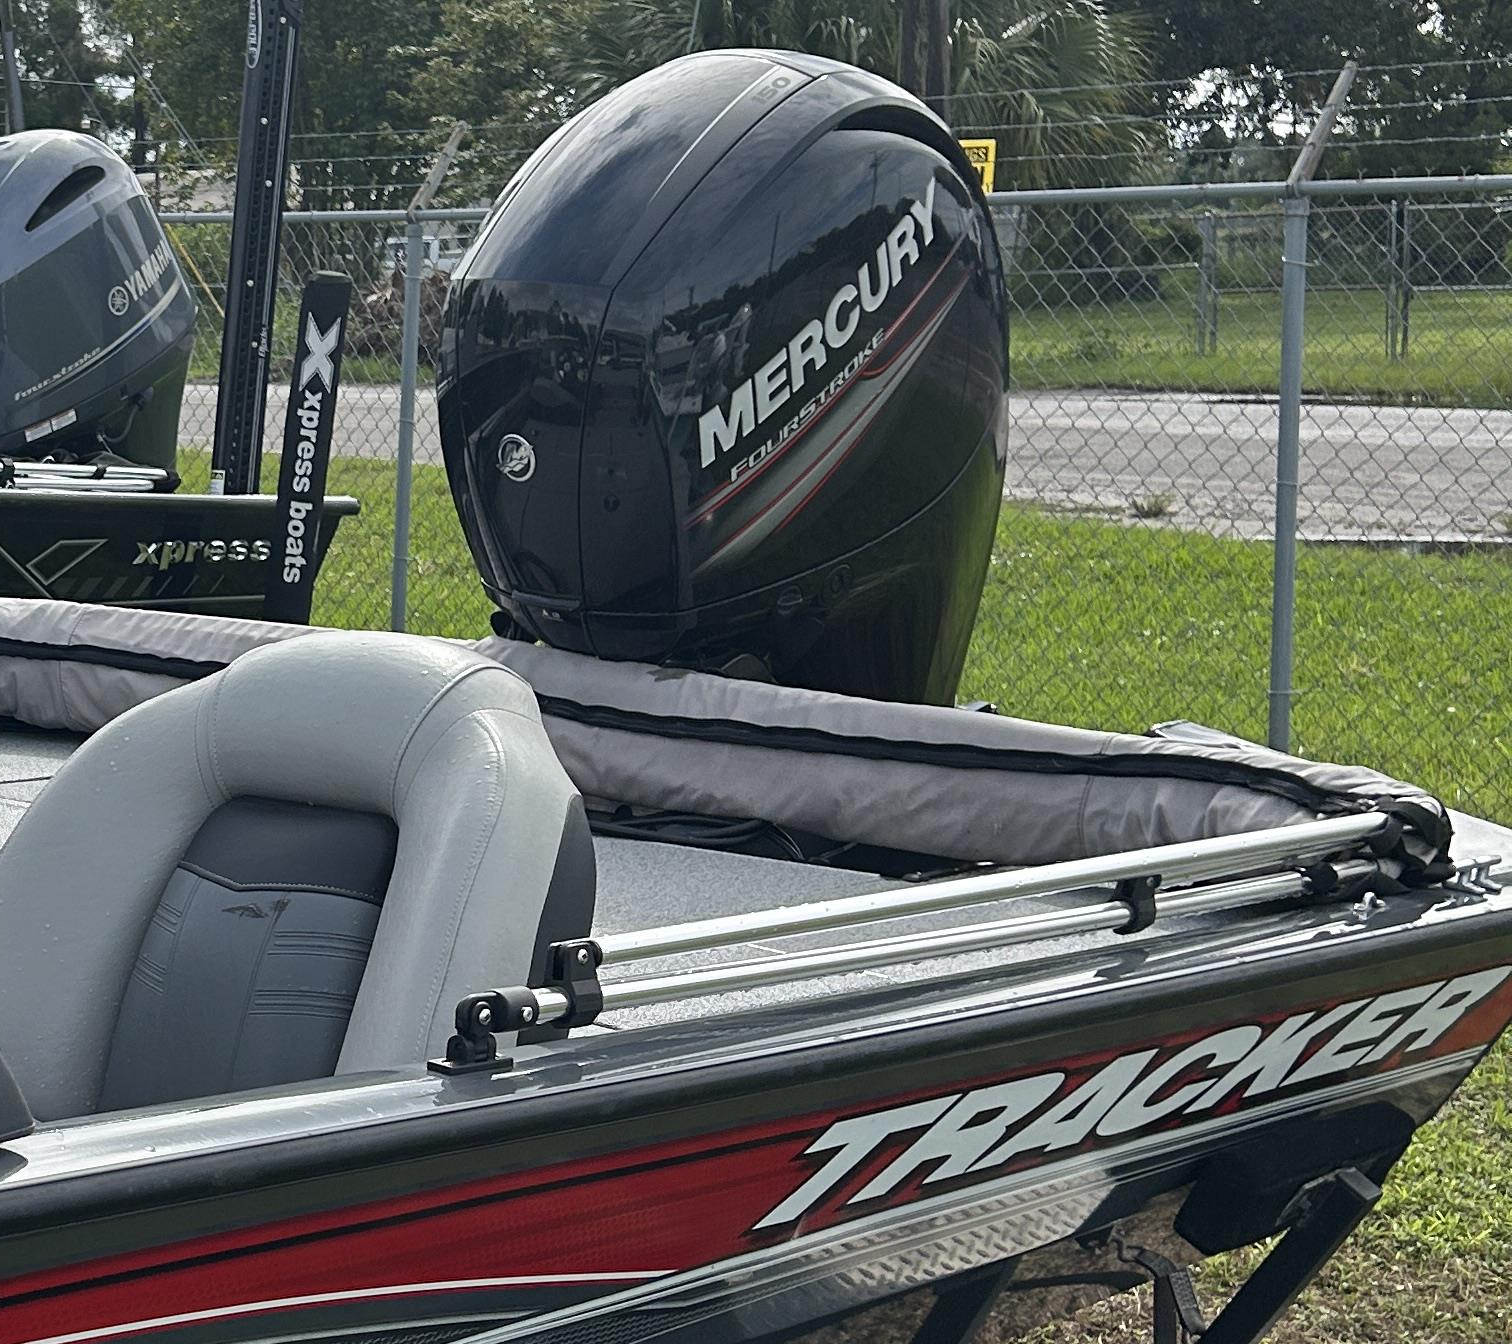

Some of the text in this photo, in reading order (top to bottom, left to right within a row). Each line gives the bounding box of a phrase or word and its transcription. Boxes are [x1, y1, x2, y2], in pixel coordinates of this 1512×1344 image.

[751, 76, 792, 105] 150
[698, 176, 936, 469] MERCURY
[291, 388, 323, 494] xpress
[730, 327, 884, 484] FOURSTROKE
[131, 539, 272, 571] xpress
[282, 499, 313, 585] boats
[751, 965, 1511, 1230] TRACKER
